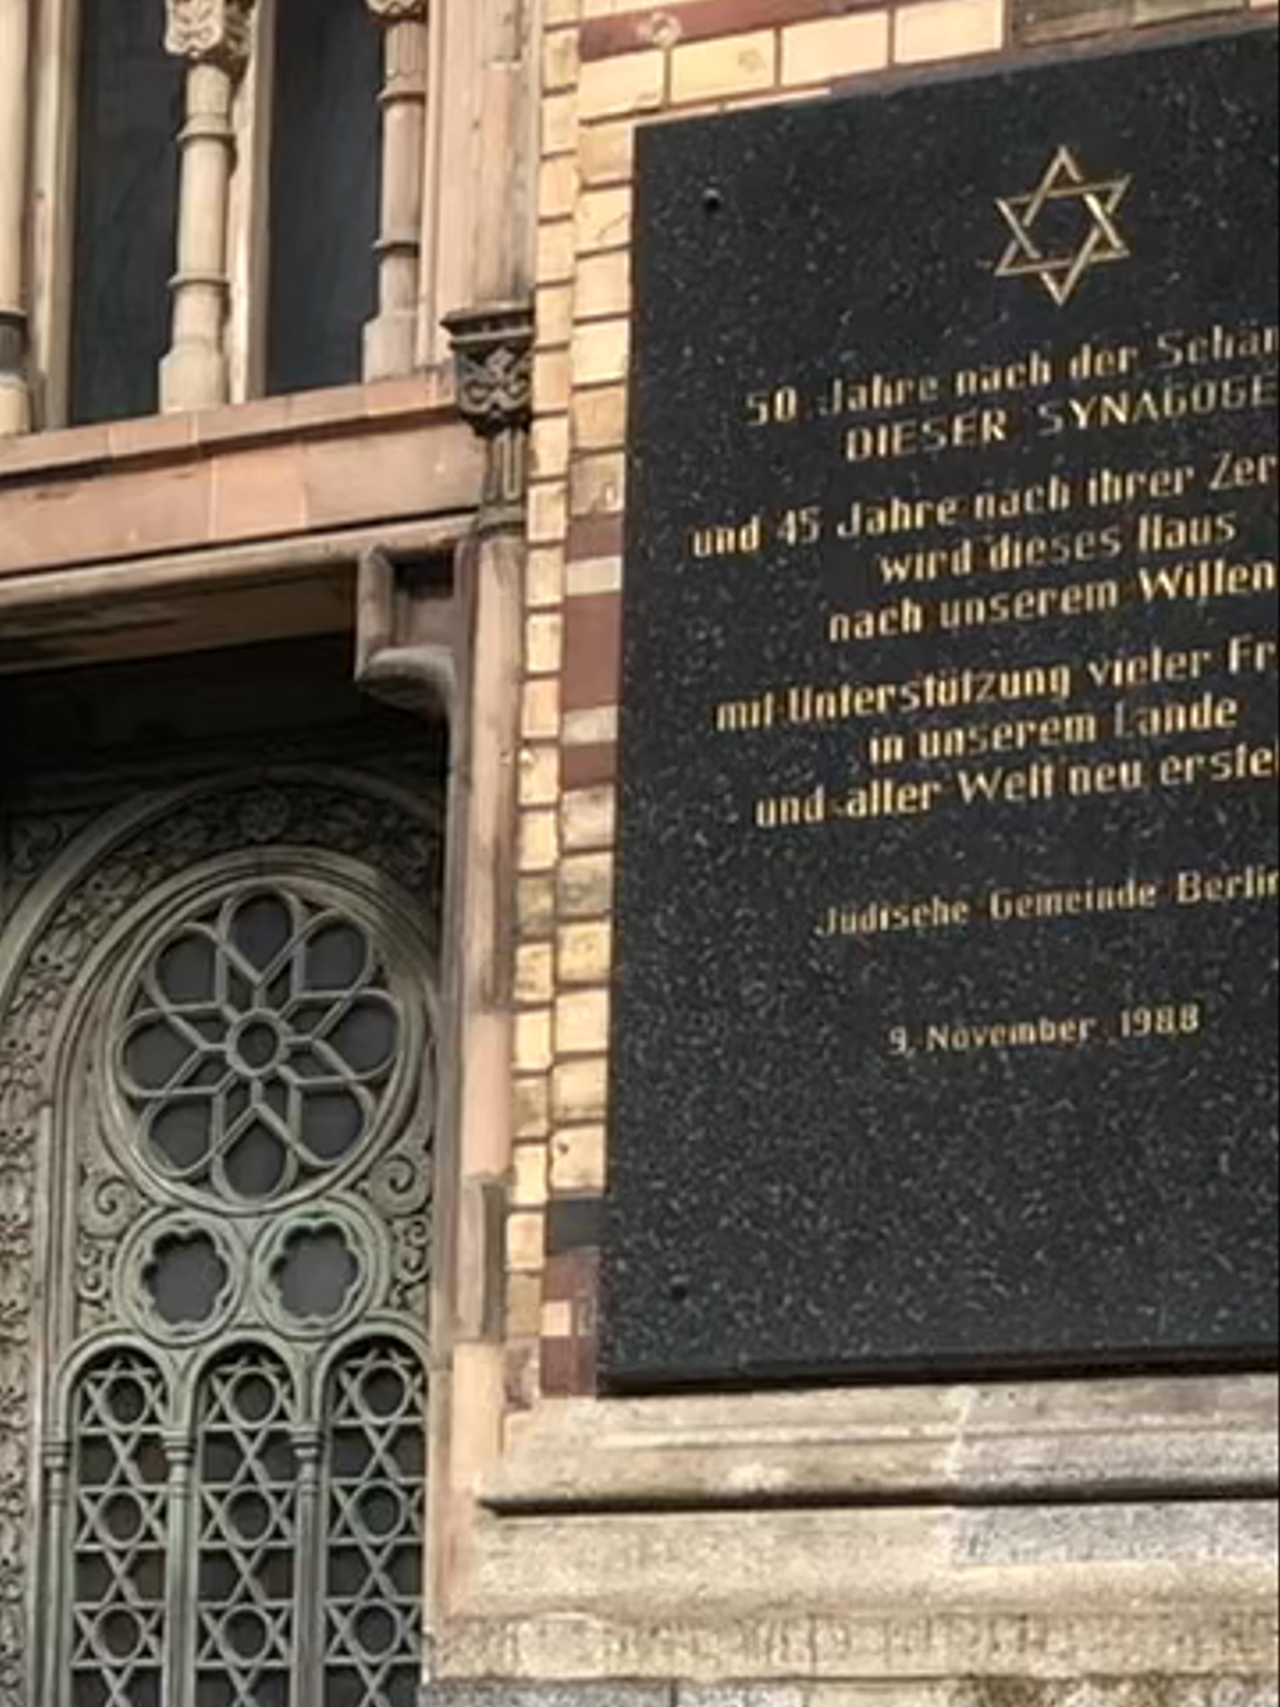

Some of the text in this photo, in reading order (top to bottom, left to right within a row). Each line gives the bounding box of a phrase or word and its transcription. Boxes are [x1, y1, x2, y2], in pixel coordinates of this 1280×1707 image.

[747, 386, 797, 426] 50
[818, 374, 938, 415] Jahre
[954, 350, 1051, 396] nach
[1069, 342, 1137, 380] der
[846, 375, 1278, 461] DIESER SYNAGOGE
[694, 448, 1277, 557] und 45 Jahre nach ihrer Zer
[879, 510, 1238, 584] wird dieses Haus
[829, 557, 1276, 642] nach unserem Willen
[789, 664, 1071, 723] Unterstützung
[1088, 644, 1211, 687] vieler
[869, 691, 1238, 764] in unserem Lande
[755, 737, 1278, 827] und aller Welt neu erste
[990, 877, 1157, 921] Gemeinde
[926, 1014, 1094, 1054] November
[1120, 1004, 1200, 1038] 1988
